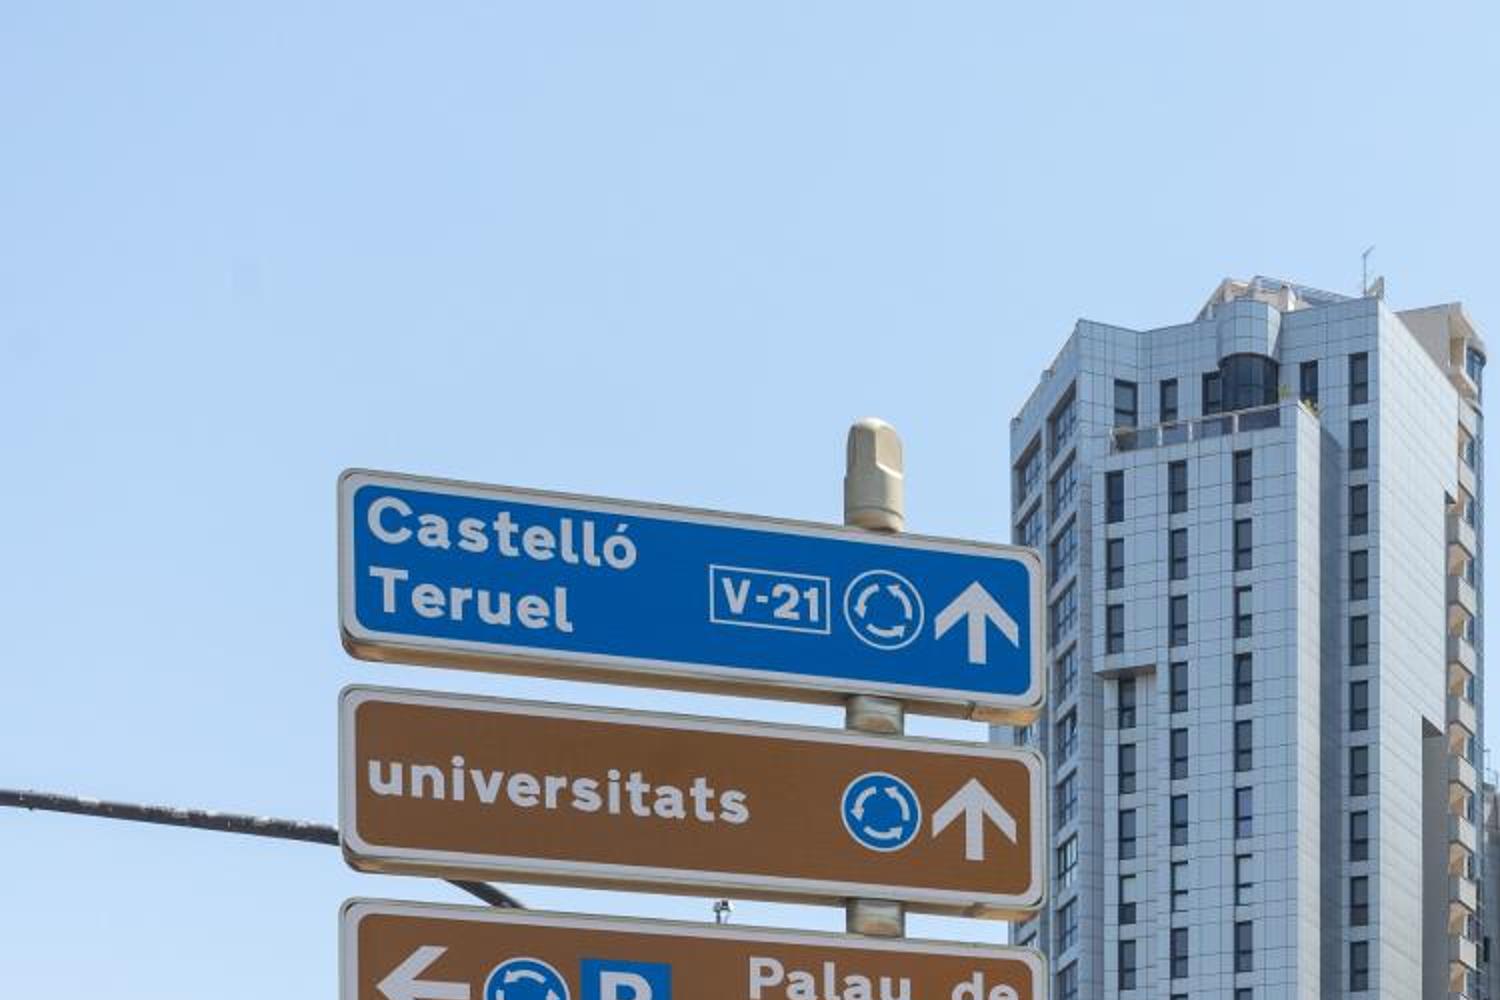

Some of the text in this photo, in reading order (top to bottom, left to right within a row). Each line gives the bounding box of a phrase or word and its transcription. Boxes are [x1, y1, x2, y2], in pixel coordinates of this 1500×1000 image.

[367, 496, 637, 569] Castelló
[369, 566, 573, 633] Teruel
[723, 577, 819, 622] V-21
[368, 755, 749, 824] universitats
